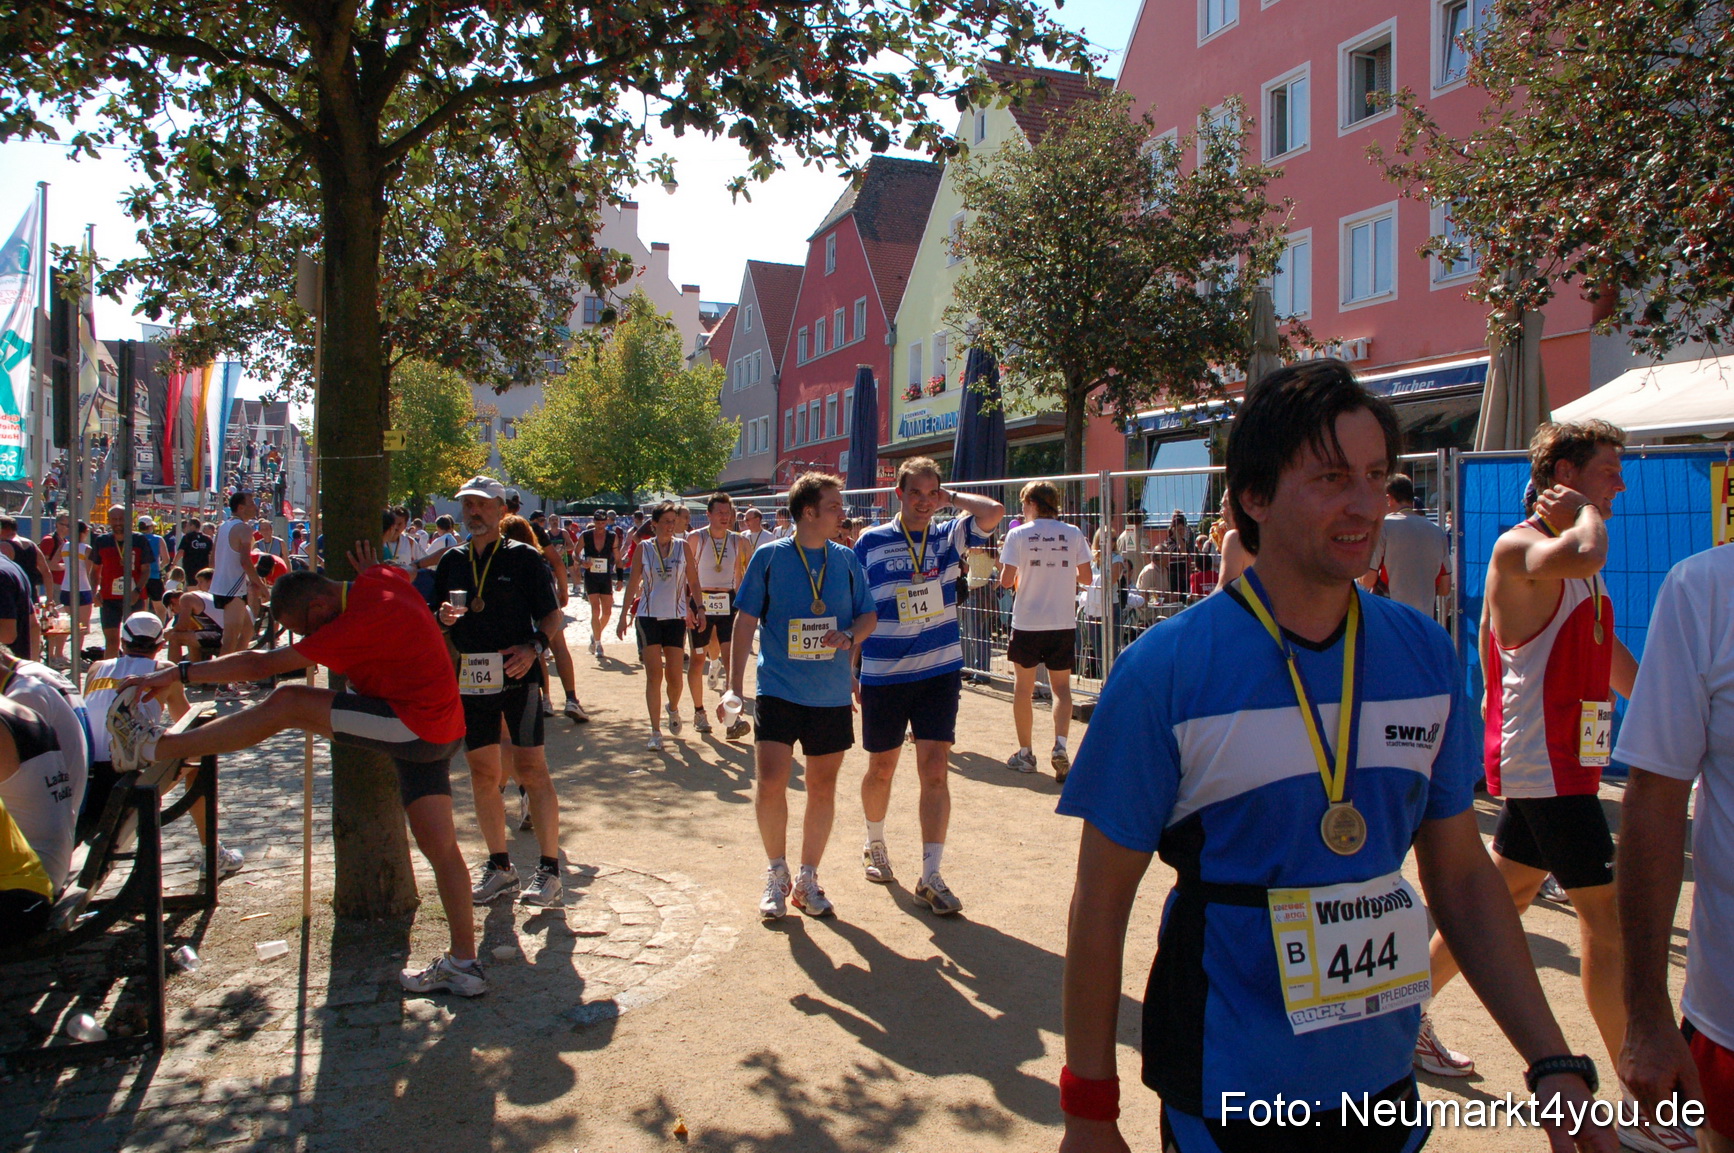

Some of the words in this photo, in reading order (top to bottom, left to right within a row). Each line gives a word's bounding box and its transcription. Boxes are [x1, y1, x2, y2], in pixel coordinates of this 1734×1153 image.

[1390, 379, 1435, 396] Tucher
[907, 587, 929, 598] Bernd
[708, 602, 724, 610] 453
[911, 601, 928, 615] 14
[802, 622, 830, 632] Andreas
[791, 634, 798, 642] B
[468, 658, 490, 667] Ludwig
[470, 670, 492, 684] 164
[1385, 725, 1427, 742] swn
[1584, 726, 1592, 737] A
[1315, 887, 1413, 926] Wolfgang
[1286, 941, 1306, 965] B
[1327, 931, 1399, 985] 444
[1380, 979, 1431, 1005] PFLEIDERER
[1290, 1001, 1347, 1026] BOCK
